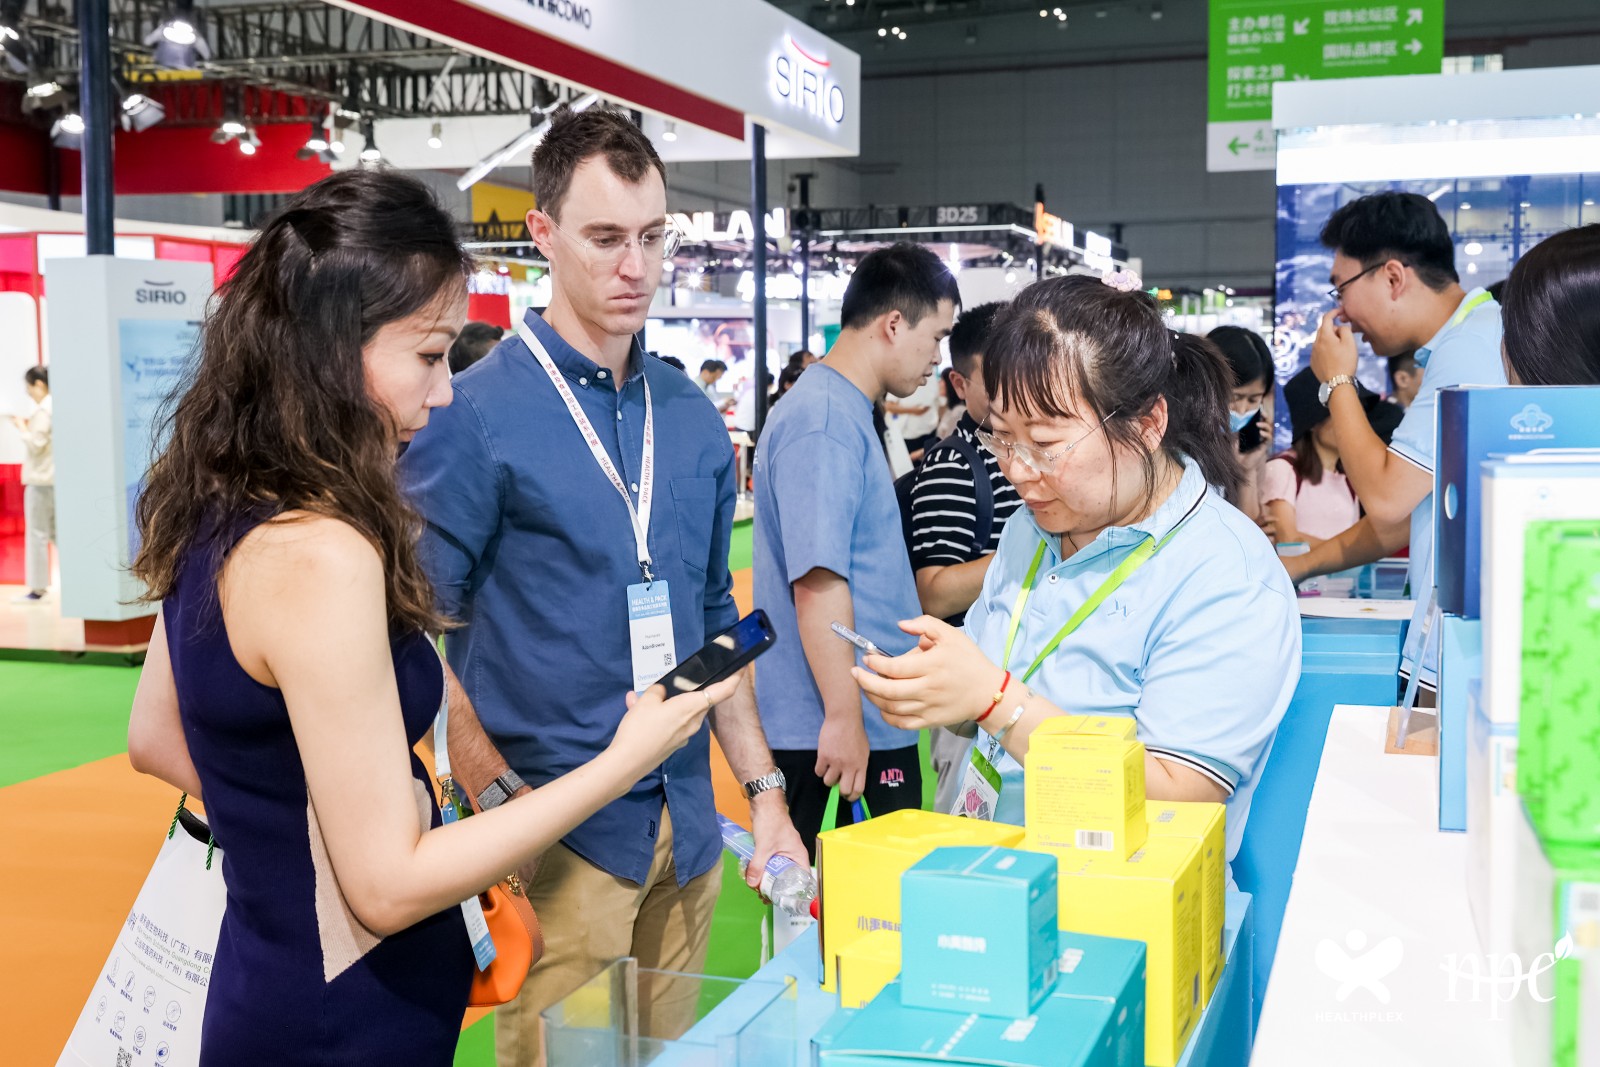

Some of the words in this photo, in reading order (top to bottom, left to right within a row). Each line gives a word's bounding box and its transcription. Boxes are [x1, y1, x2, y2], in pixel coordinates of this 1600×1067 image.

[775, 56, 845, 124] SIRIO
[936, 207, 978, 224] 3D25
[135, 289, 187, 304] SIRIO
[600, 456, 618, 482] HEALTH
[641, 487, 649, 504] PACK
[880, 768, 904, 784] ANTA
